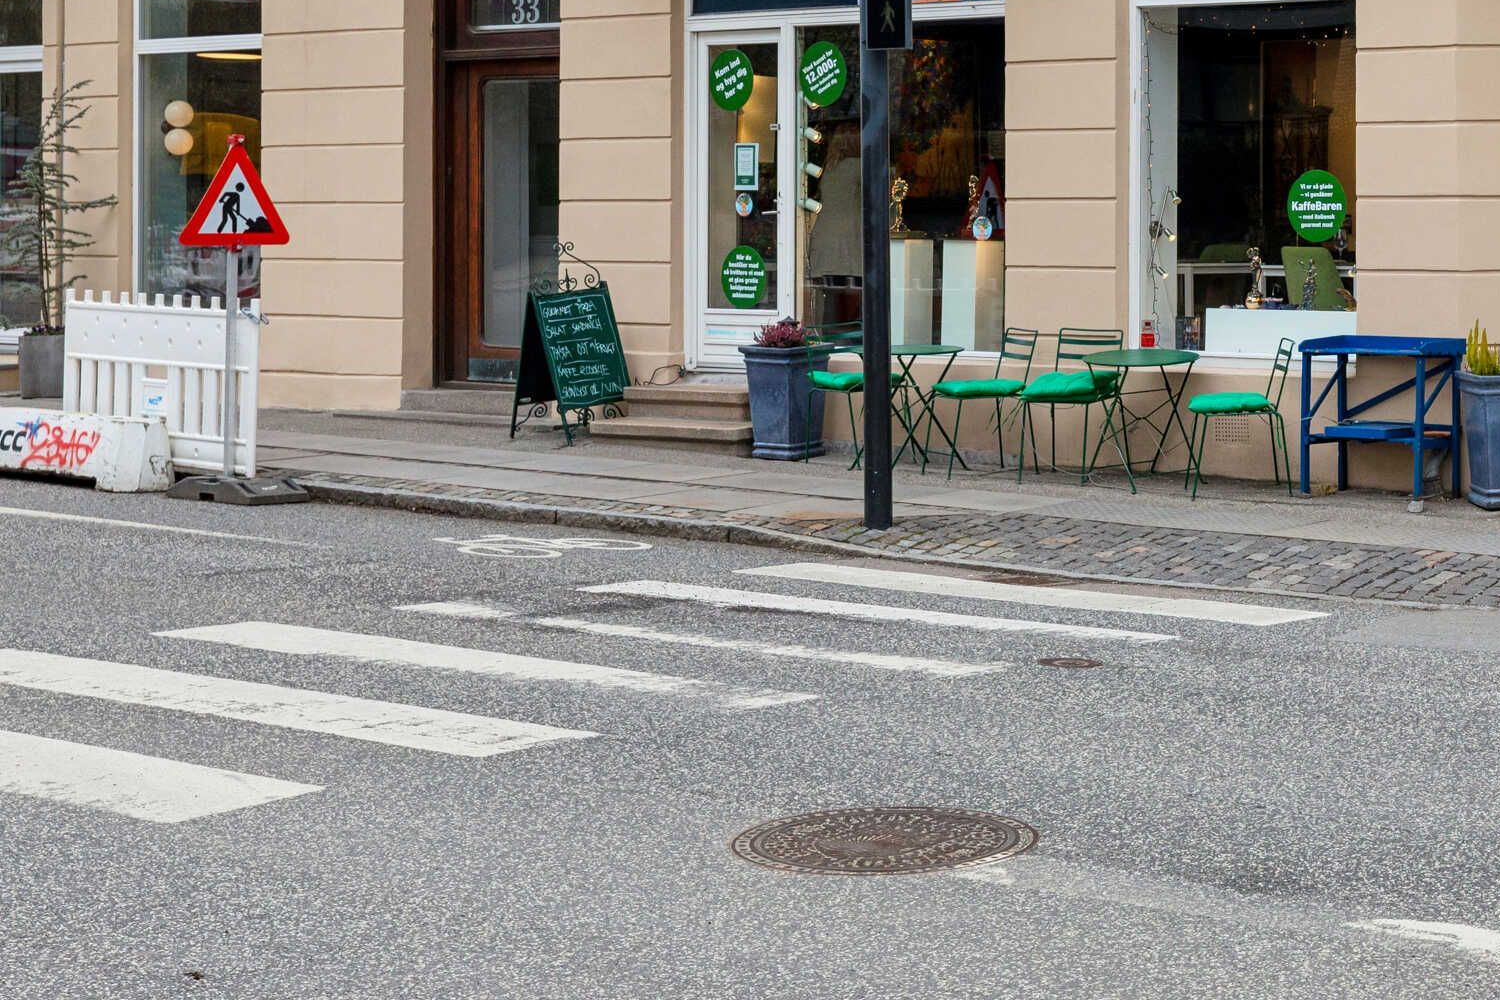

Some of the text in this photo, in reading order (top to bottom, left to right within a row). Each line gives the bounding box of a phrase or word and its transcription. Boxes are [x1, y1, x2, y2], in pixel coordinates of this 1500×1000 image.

[714, 56, 741, 79] Kom ind
[715, 67, 748, 92] og hyg dig
[724, 87, 736, 100] her
[1291, 200, 1343, 211] KaffeBaren
